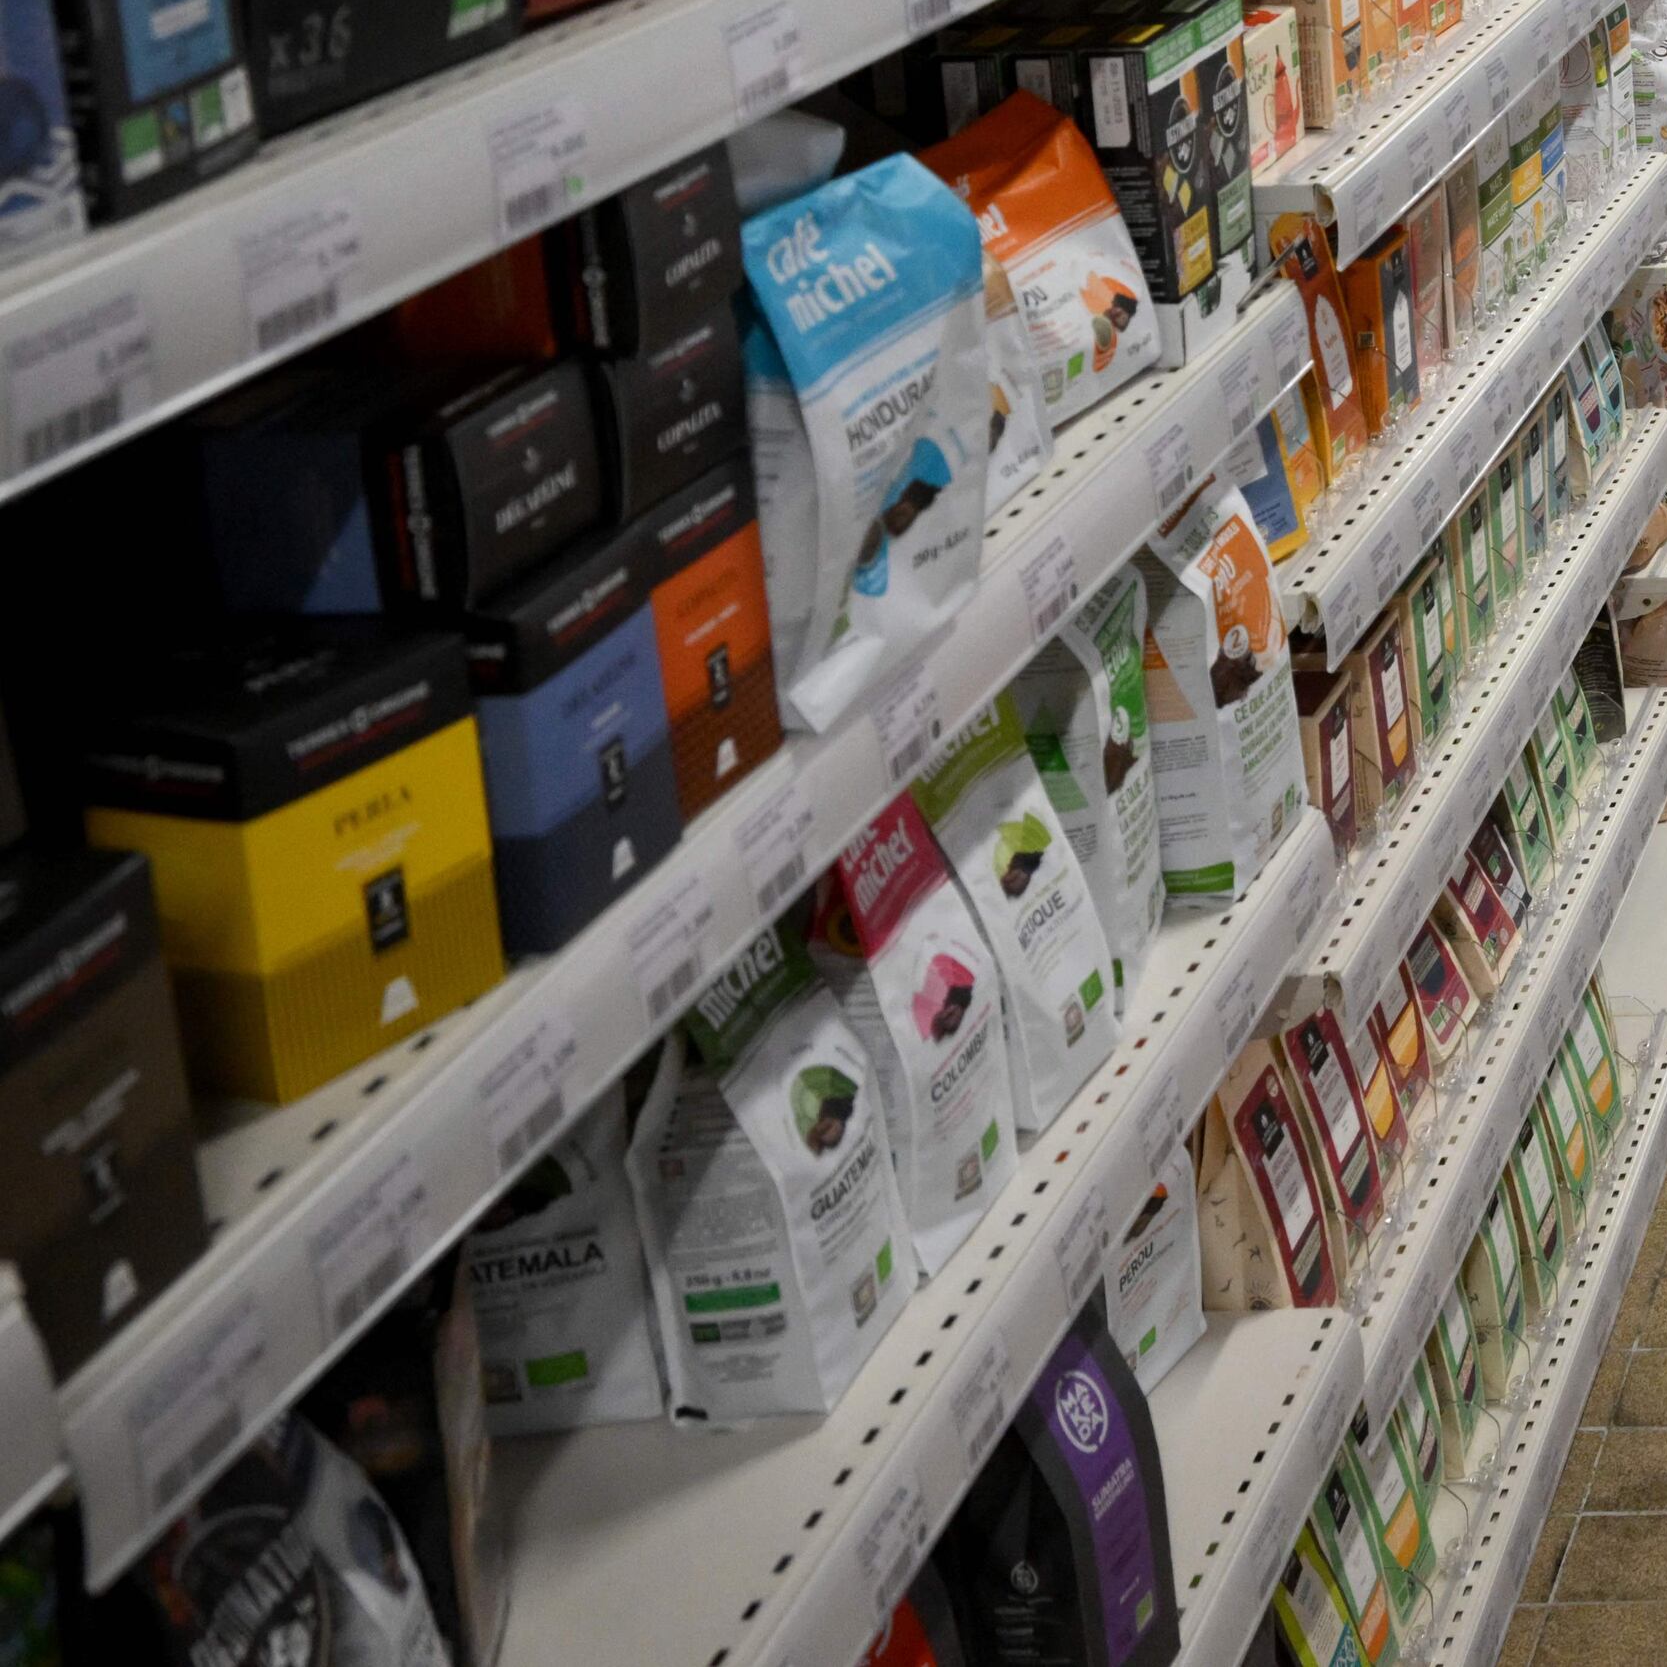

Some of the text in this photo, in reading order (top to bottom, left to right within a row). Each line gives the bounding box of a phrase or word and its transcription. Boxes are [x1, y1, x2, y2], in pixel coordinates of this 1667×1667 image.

[767, 207, 829, 285] café
[1231, 629, 1243, 650] 2
[1118, 1241, 1154, 1293] PÉROU
[1090, 1456, 1133, 1510] SUMATRA
